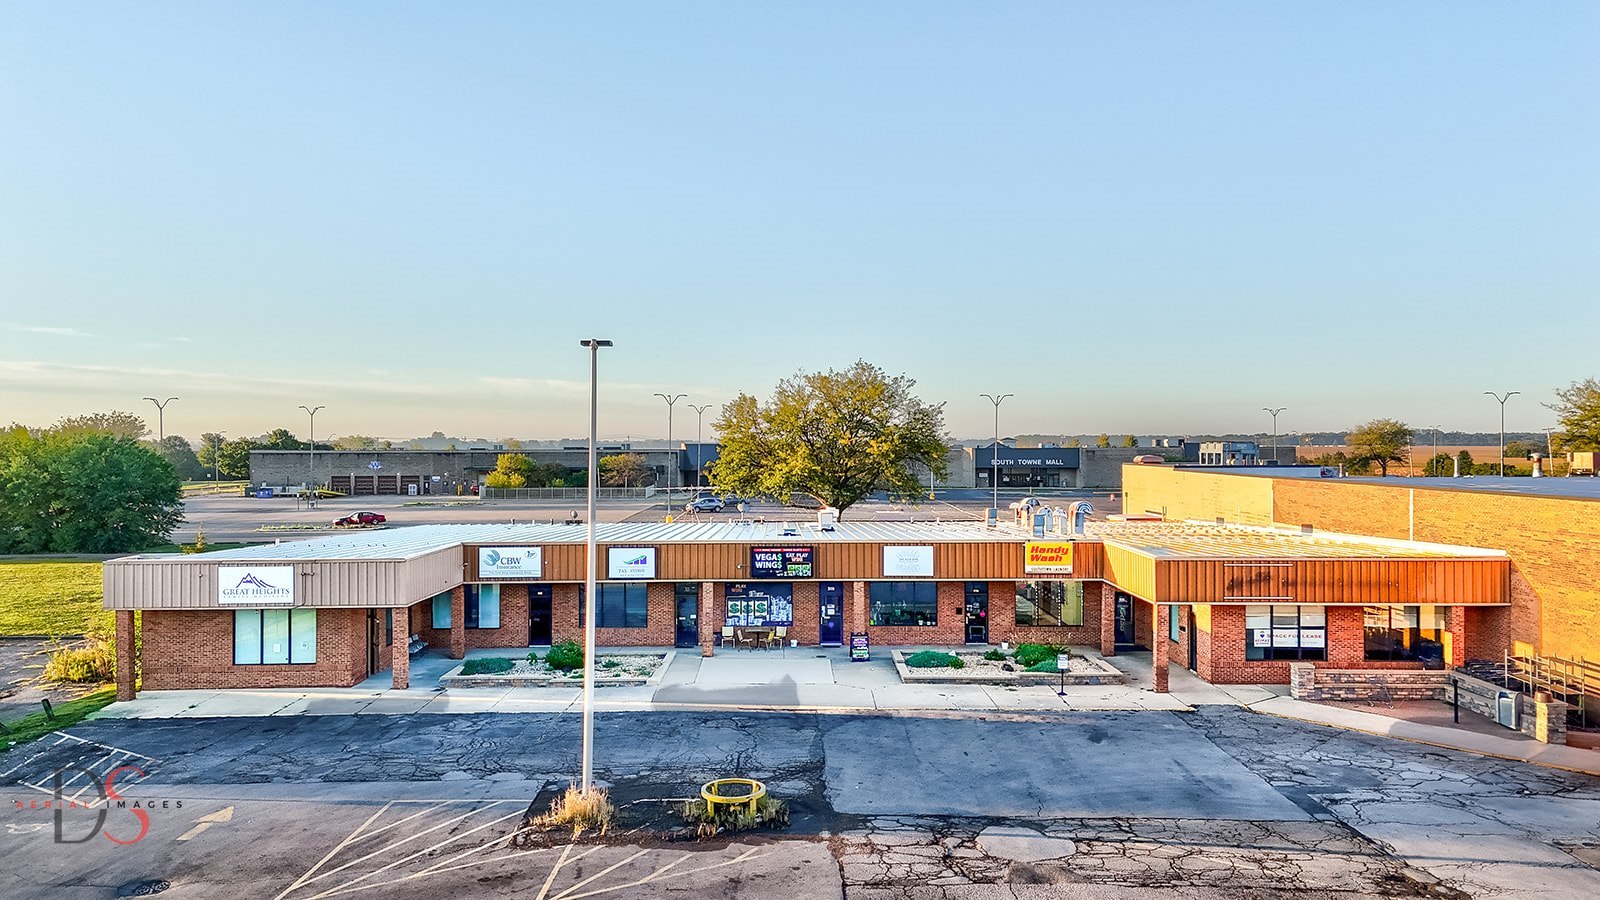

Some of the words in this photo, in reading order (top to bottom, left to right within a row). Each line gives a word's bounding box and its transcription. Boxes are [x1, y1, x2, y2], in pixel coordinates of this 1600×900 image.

[1030, 546, 1069, 555] Handy
[500, 557, 521, 565] CBW
[755, 553, 782, 561] VEGA$
[1030, 554, 1063, 562] Wash
[755, 561, 782, 569] WING$
